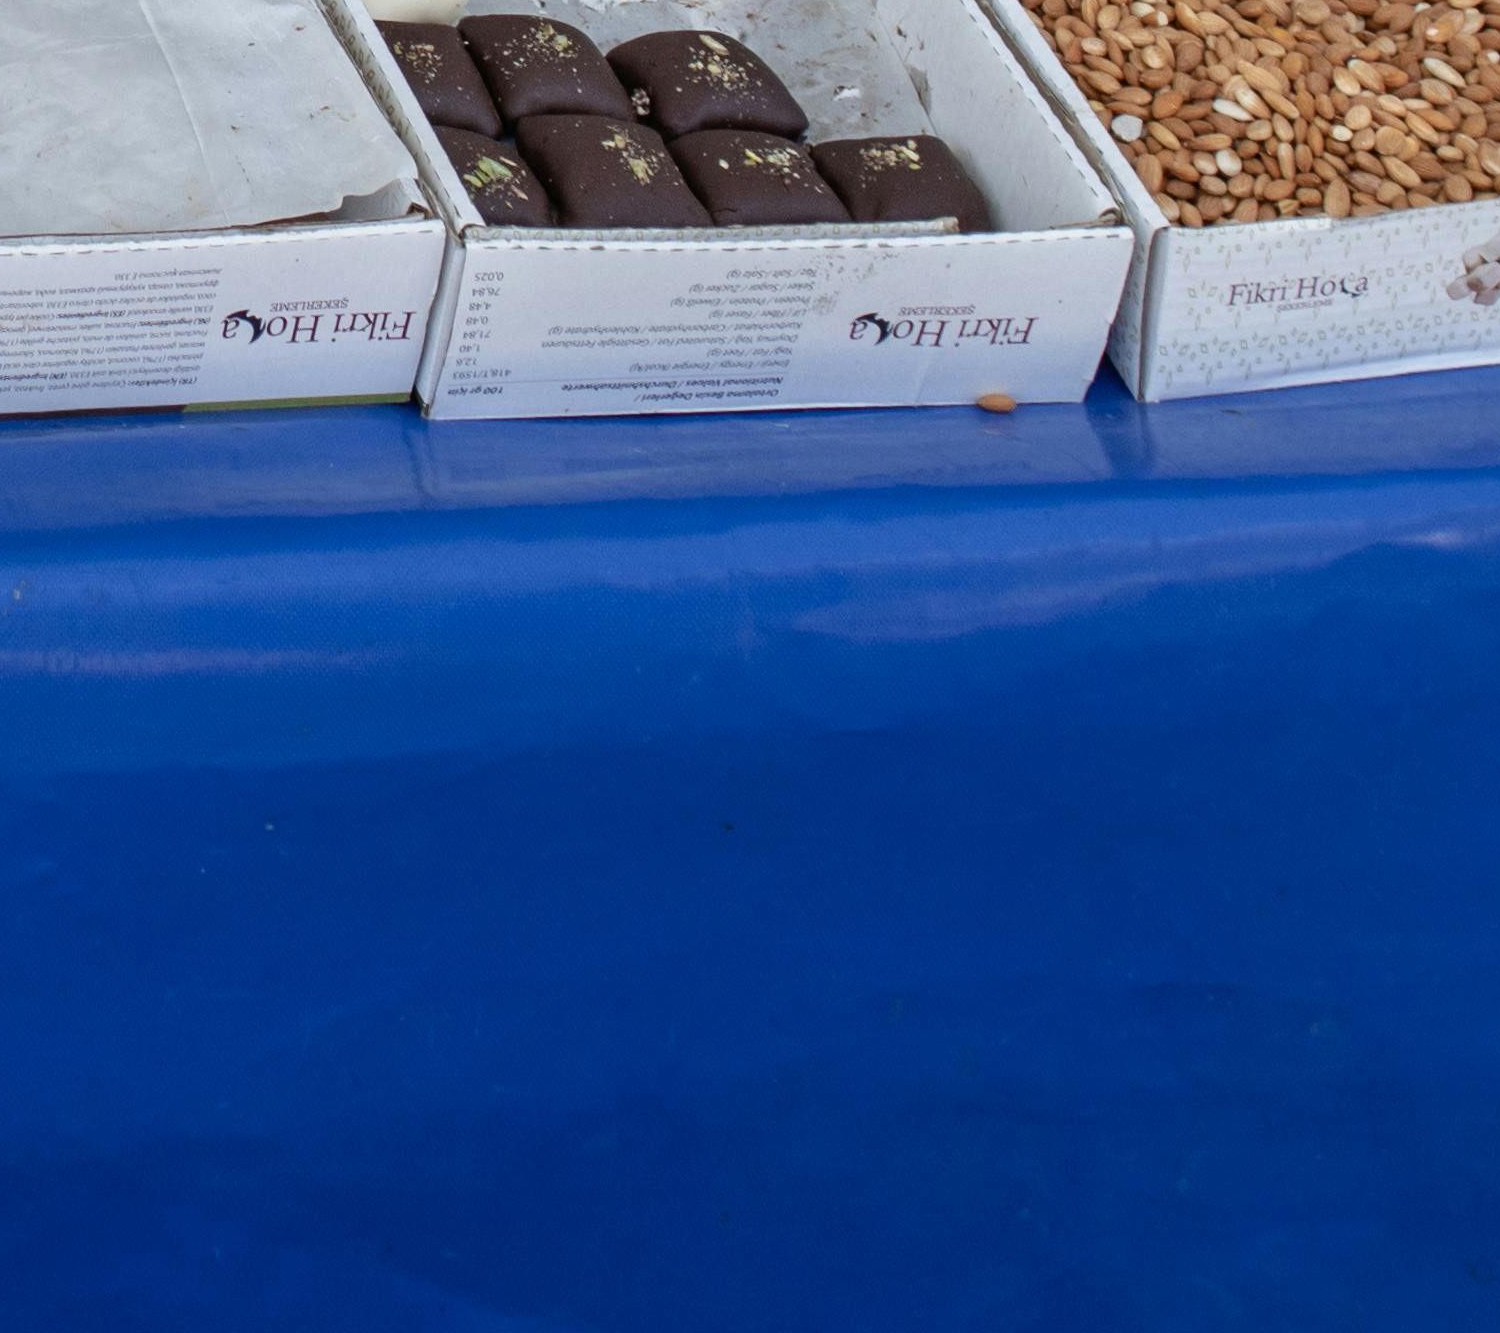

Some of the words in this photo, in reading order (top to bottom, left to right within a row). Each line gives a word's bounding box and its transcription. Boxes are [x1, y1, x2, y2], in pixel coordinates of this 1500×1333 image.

[472, 271, 504, 281] 0,025
[1227, 278, 1289, 307] Fikri
[464, 315, 489, 325] 0,48
[331, 312, 417, 343] Fikri
[954, 316, 1040, 348] Fikri
[461, 329, 491, 338] 71,84
[458, 343, 482, 352] 1,40
[482, 386, 504, 394] 100
